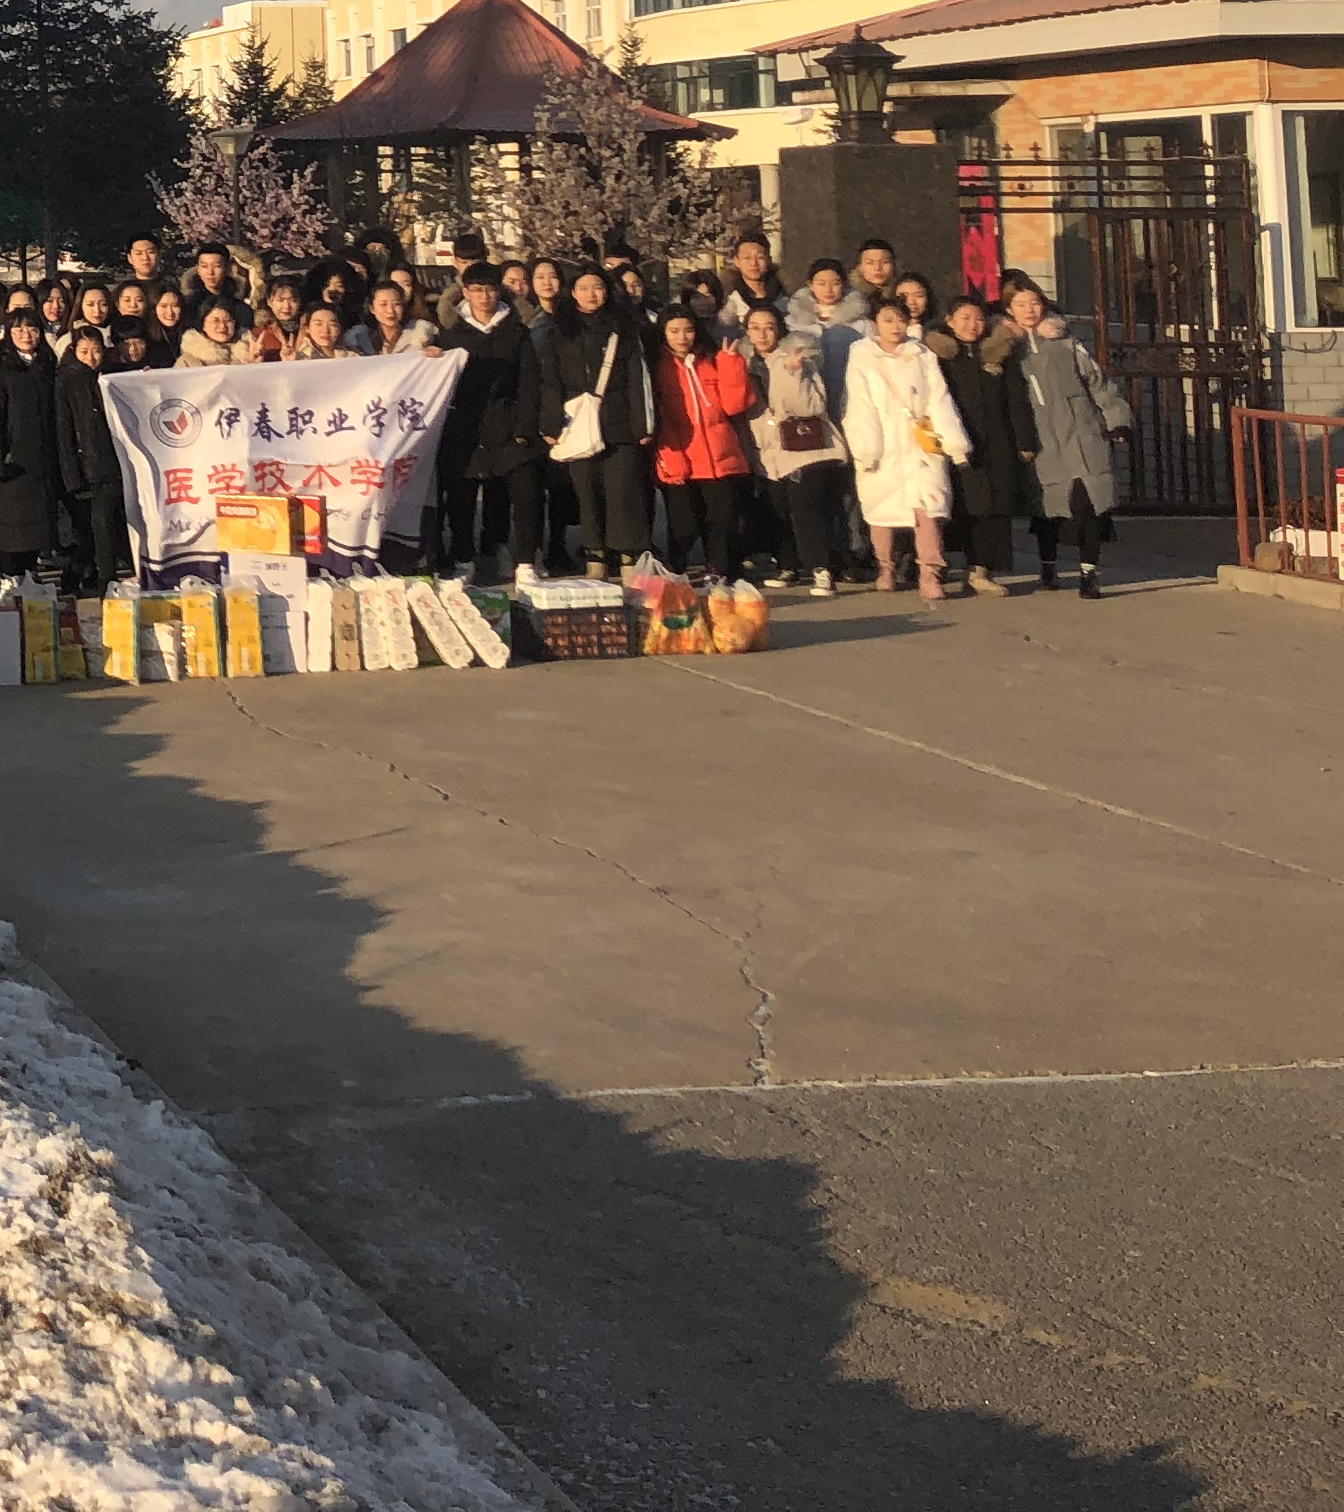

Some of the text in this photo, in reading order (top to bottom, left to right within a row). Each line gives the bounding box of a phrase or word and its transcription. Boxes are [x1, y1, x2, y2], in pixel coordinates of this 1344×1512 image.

[214, 396, 428, 443] 伊春职业学院
